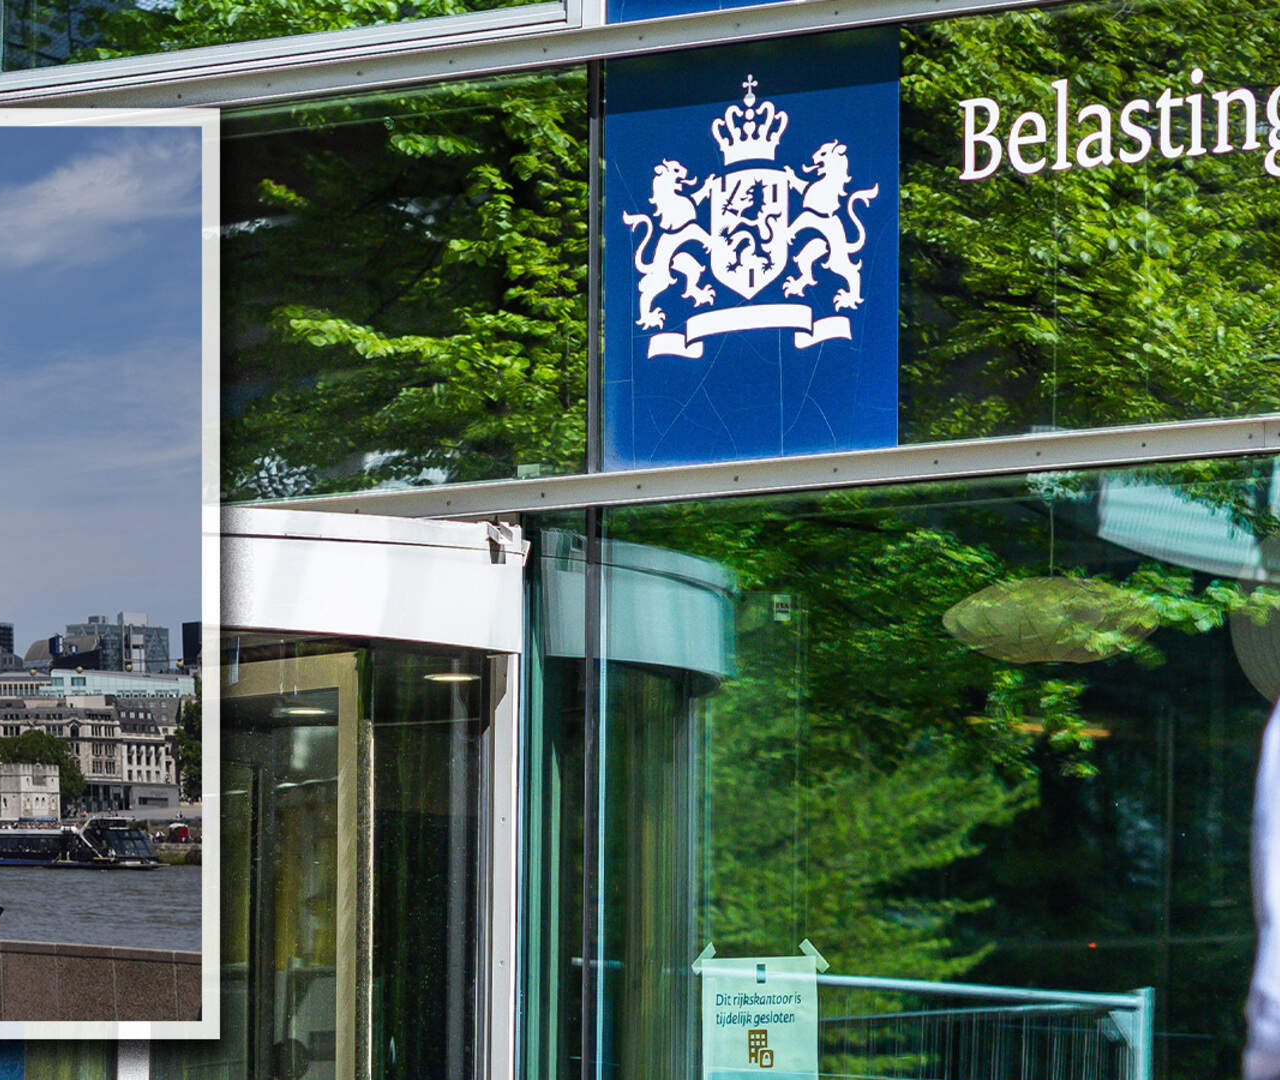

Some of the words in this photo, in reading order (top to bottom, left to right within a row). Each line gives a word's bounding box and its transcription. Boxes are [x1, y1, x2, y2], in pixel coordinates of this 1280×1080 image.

[715, 993, 732, 1007] Dit
[733, 992, 794, 1009] rijkskantoor
[794, 992, 802, 1005] is
[715, 1011, 753, 1028] tijdelijk
[753, 1011, 796, 1028] gesloten
